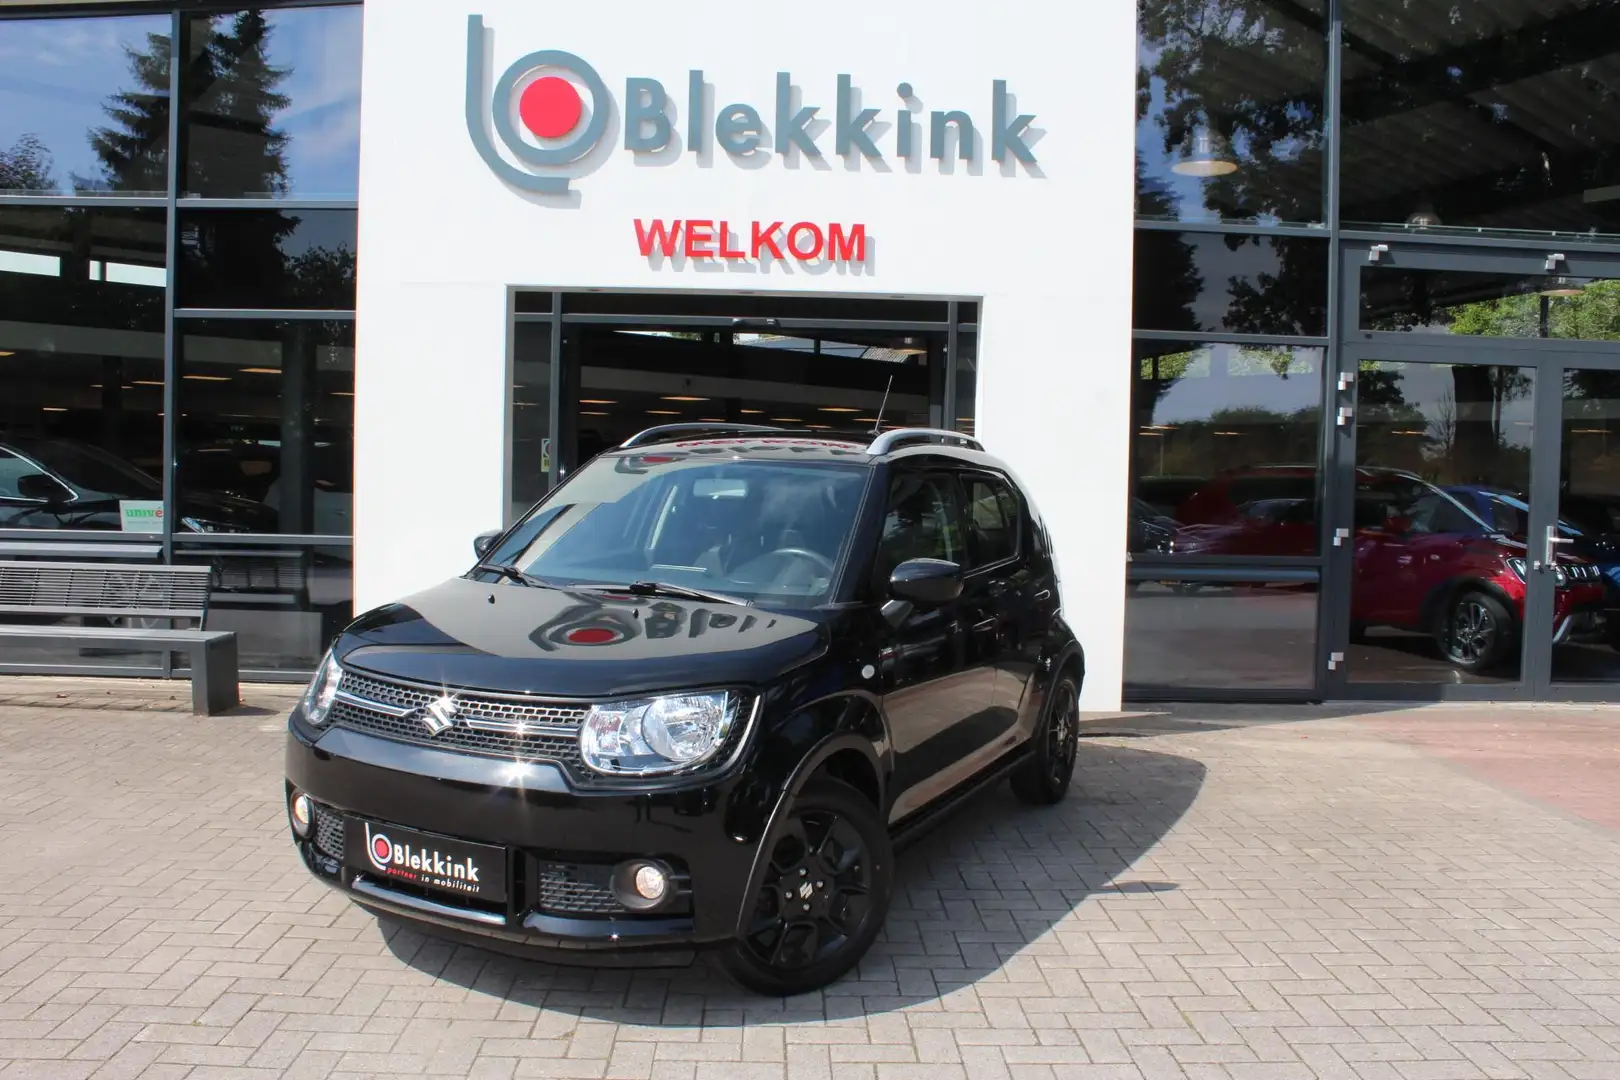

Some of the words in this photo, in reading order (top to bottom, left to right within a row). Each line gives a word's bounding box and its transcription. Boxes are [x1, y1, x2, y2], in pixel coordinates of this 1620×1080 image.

[623, 69, 1038, 164] Blekkink
[633, 218, 867, 262] WELKOM
[386, 867, 418, 880] partner
[421, 874, 430, 882] in
[433, 878, 480, 893] mobiliteit
[393, 844, 480, 882] Blekkink
